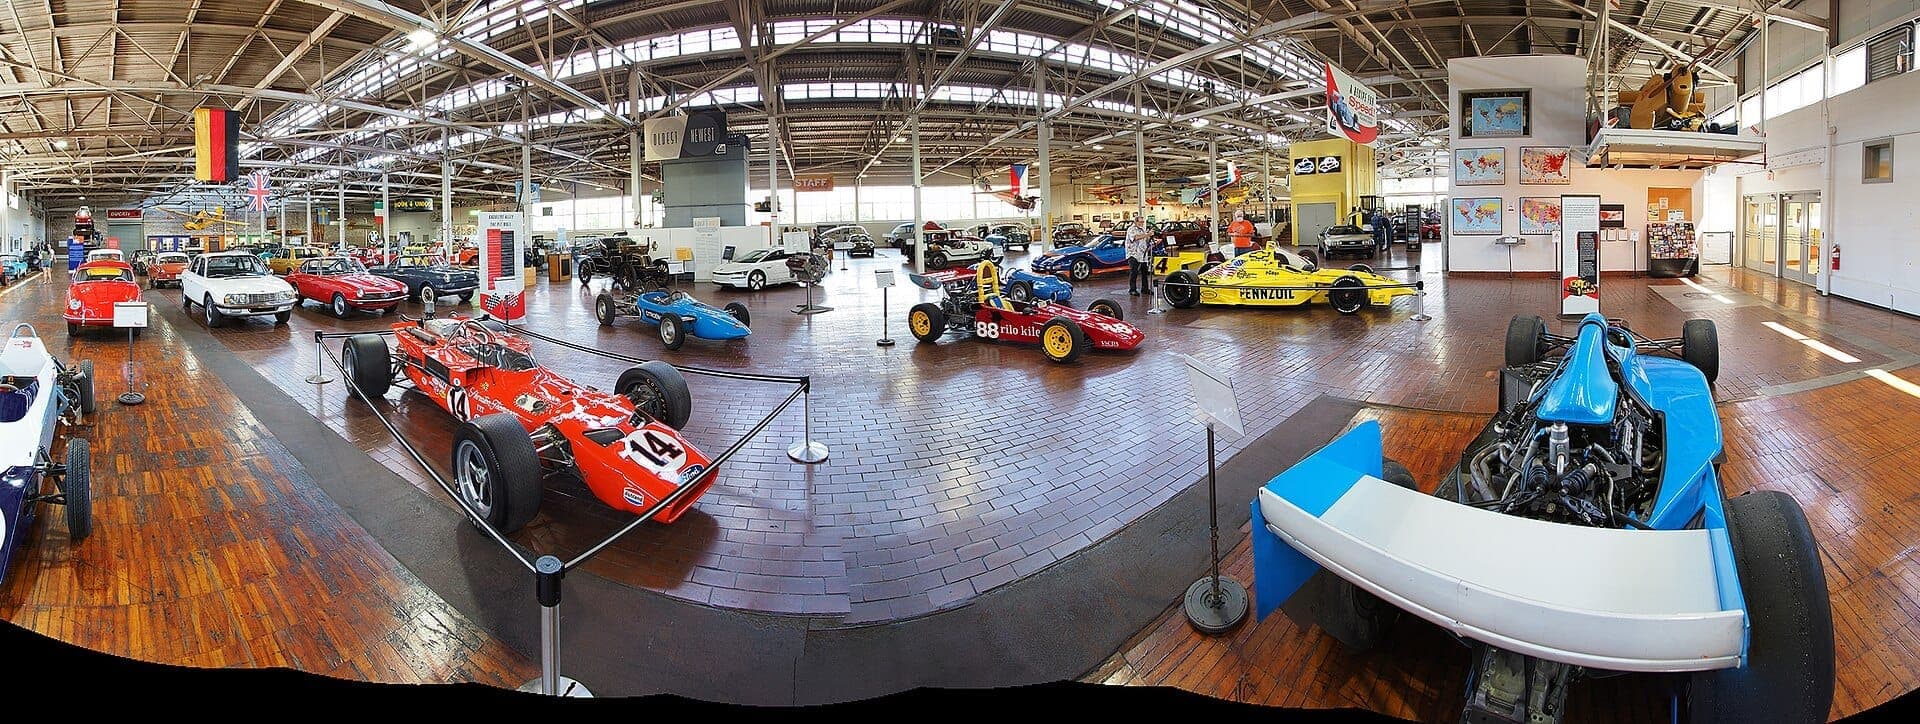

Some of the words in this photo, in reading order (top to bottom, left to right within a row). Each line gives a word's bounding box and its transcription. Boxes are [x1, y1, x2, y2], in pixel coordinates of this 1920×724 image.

[653, 131, 678, 146] OLDEST
[690, 127, 714, 144] NEWEST
[795, 178, 828, 187] STAFF
[1155, 257, 1168, 274] 4
[976, 321, 999, 339] 88
[1000, 325, 1019, 336] rilo
[449, 387, 469, 422] 14
[629, 431, 684, 467] 14
[682, 465, 700, 482] Ford
